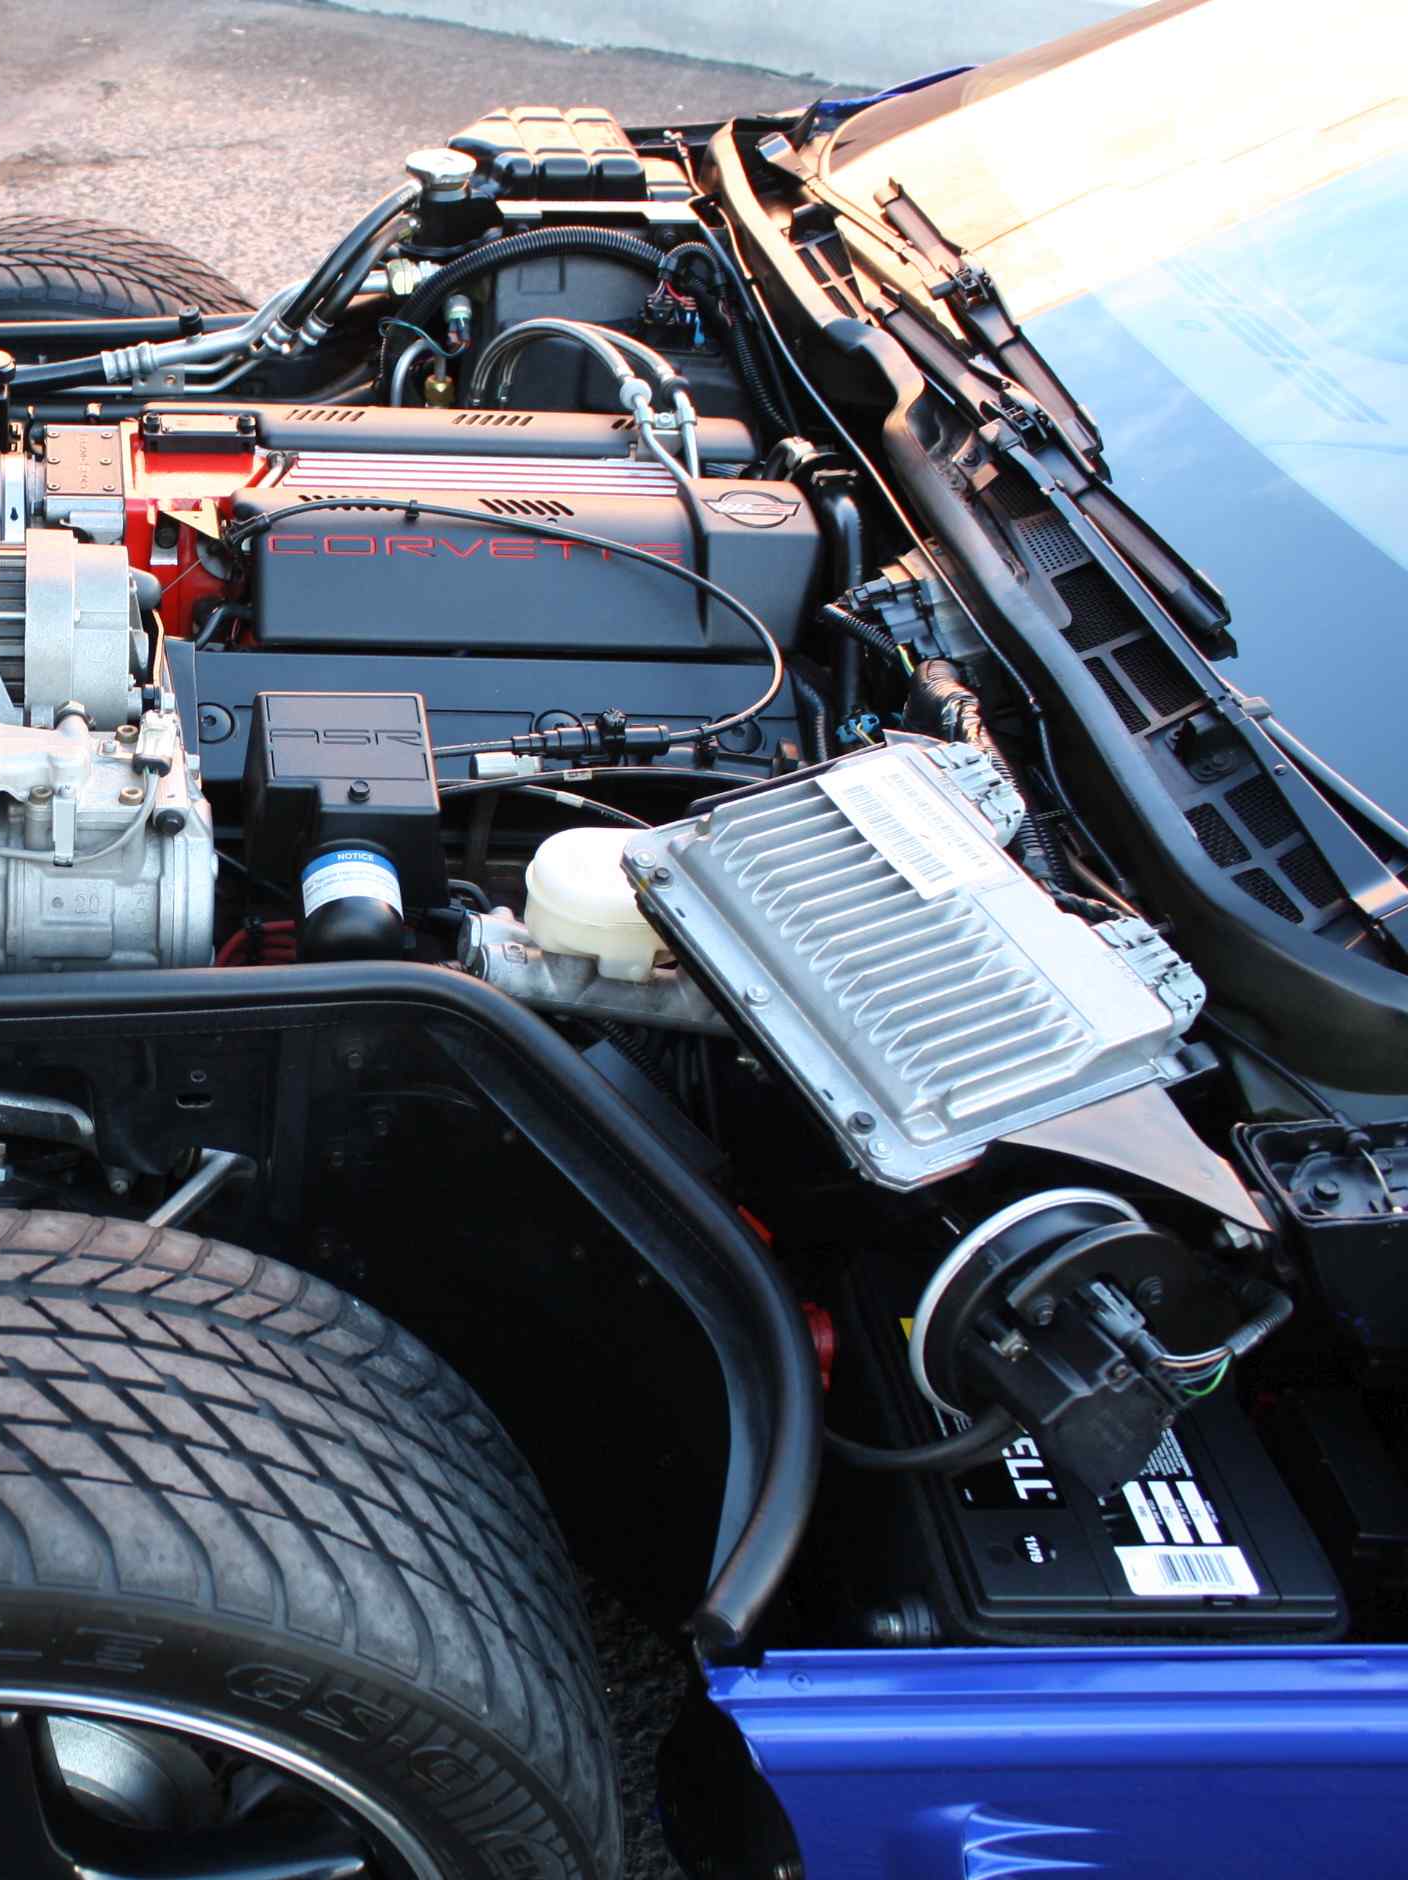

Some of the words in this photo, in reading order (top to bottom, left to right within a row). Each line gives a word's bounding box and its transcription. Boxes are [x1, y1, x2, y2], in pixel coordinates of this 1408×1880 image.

[266, 534, 684, 563] CORVETE
[269, 728, 424, 747] ASR
[336, 852, 375, 862] NOTICE
